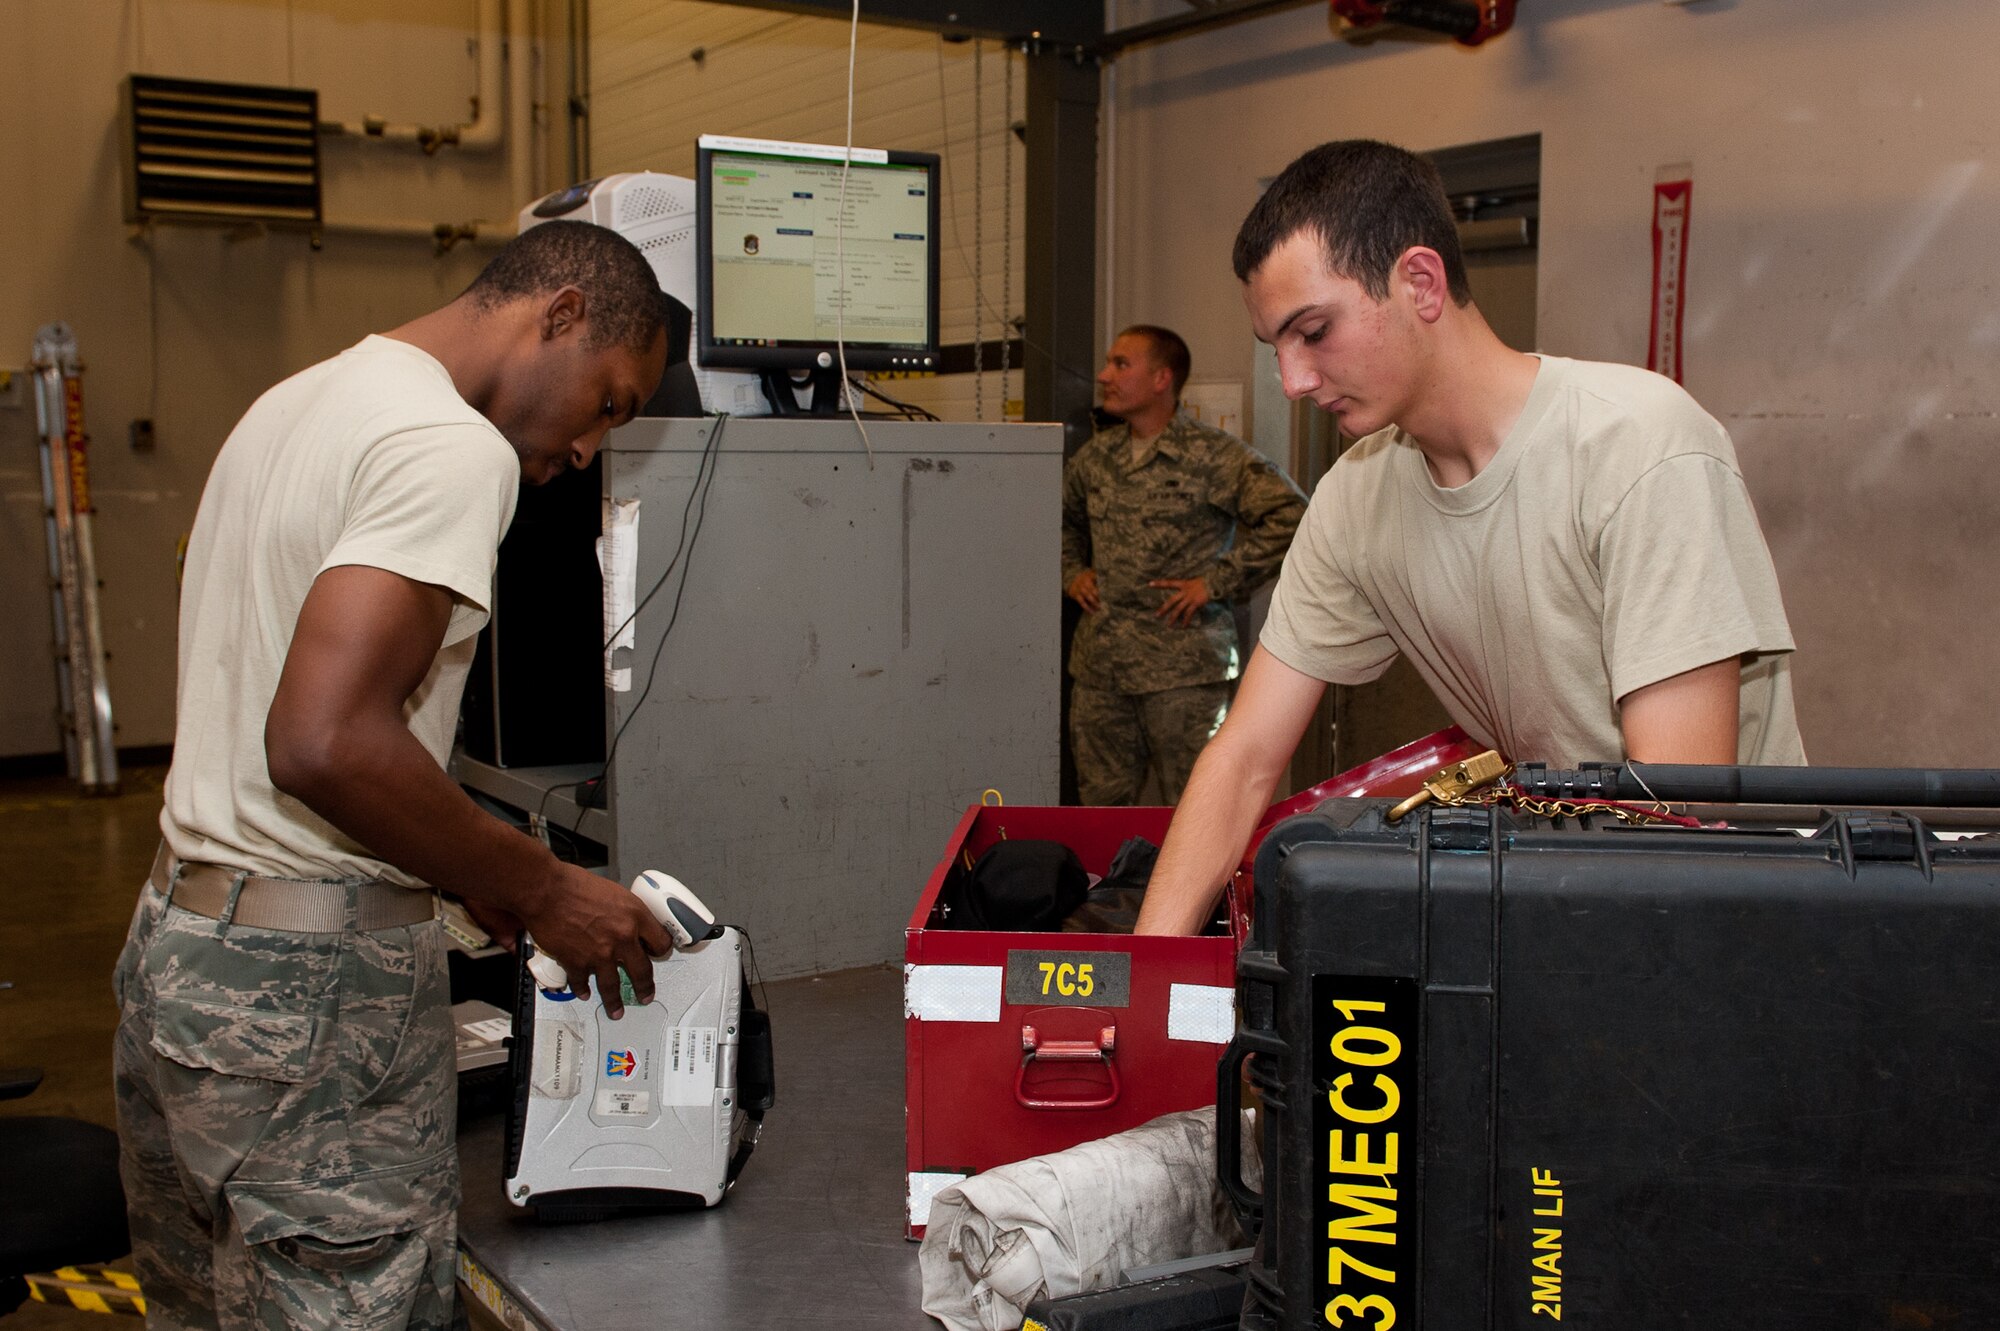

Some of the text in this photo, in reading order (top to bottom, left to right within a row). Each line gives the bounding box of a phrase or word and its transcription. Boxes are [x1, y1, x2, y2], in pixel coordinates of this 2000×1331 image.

[1663, 208, 1684, 217] FIRE
[1038, 962, 1095, 997] 7C5
[1325, 999, 1402, 1331] 37MEC01
[1531, 1166, 1565, 1322] 2MAN LIF
